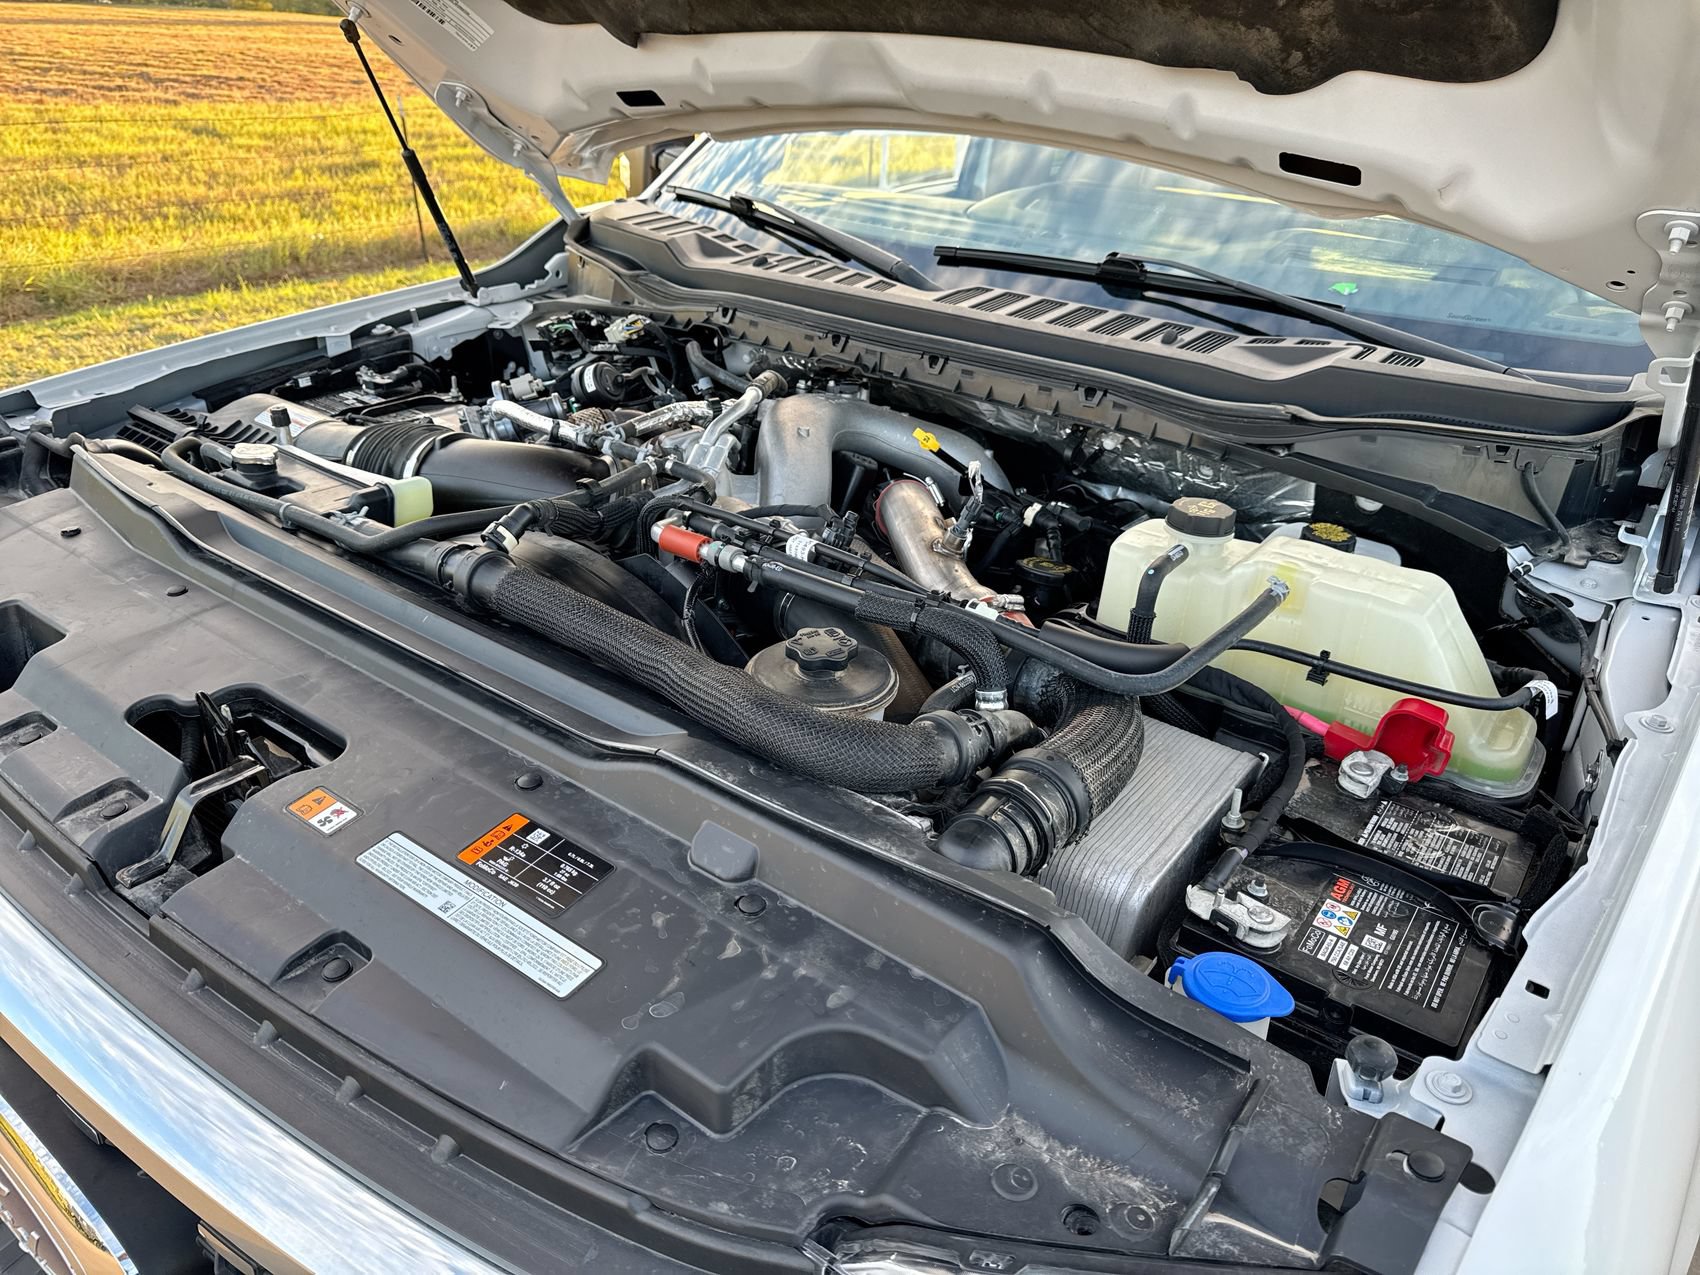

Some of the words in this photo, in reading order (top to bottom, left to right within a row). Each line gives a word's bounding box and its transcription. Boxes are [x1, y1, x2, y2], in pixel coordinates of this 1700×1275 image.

[476, 861, 496, 875] FoMoCo
[462, 878, 506, 908] MODIFICATION
[1331, 878, 1350, 900] AGM
[1374, 923, 1387, 936] MF
[1303, 930, 1321, 952] FoMoCo
